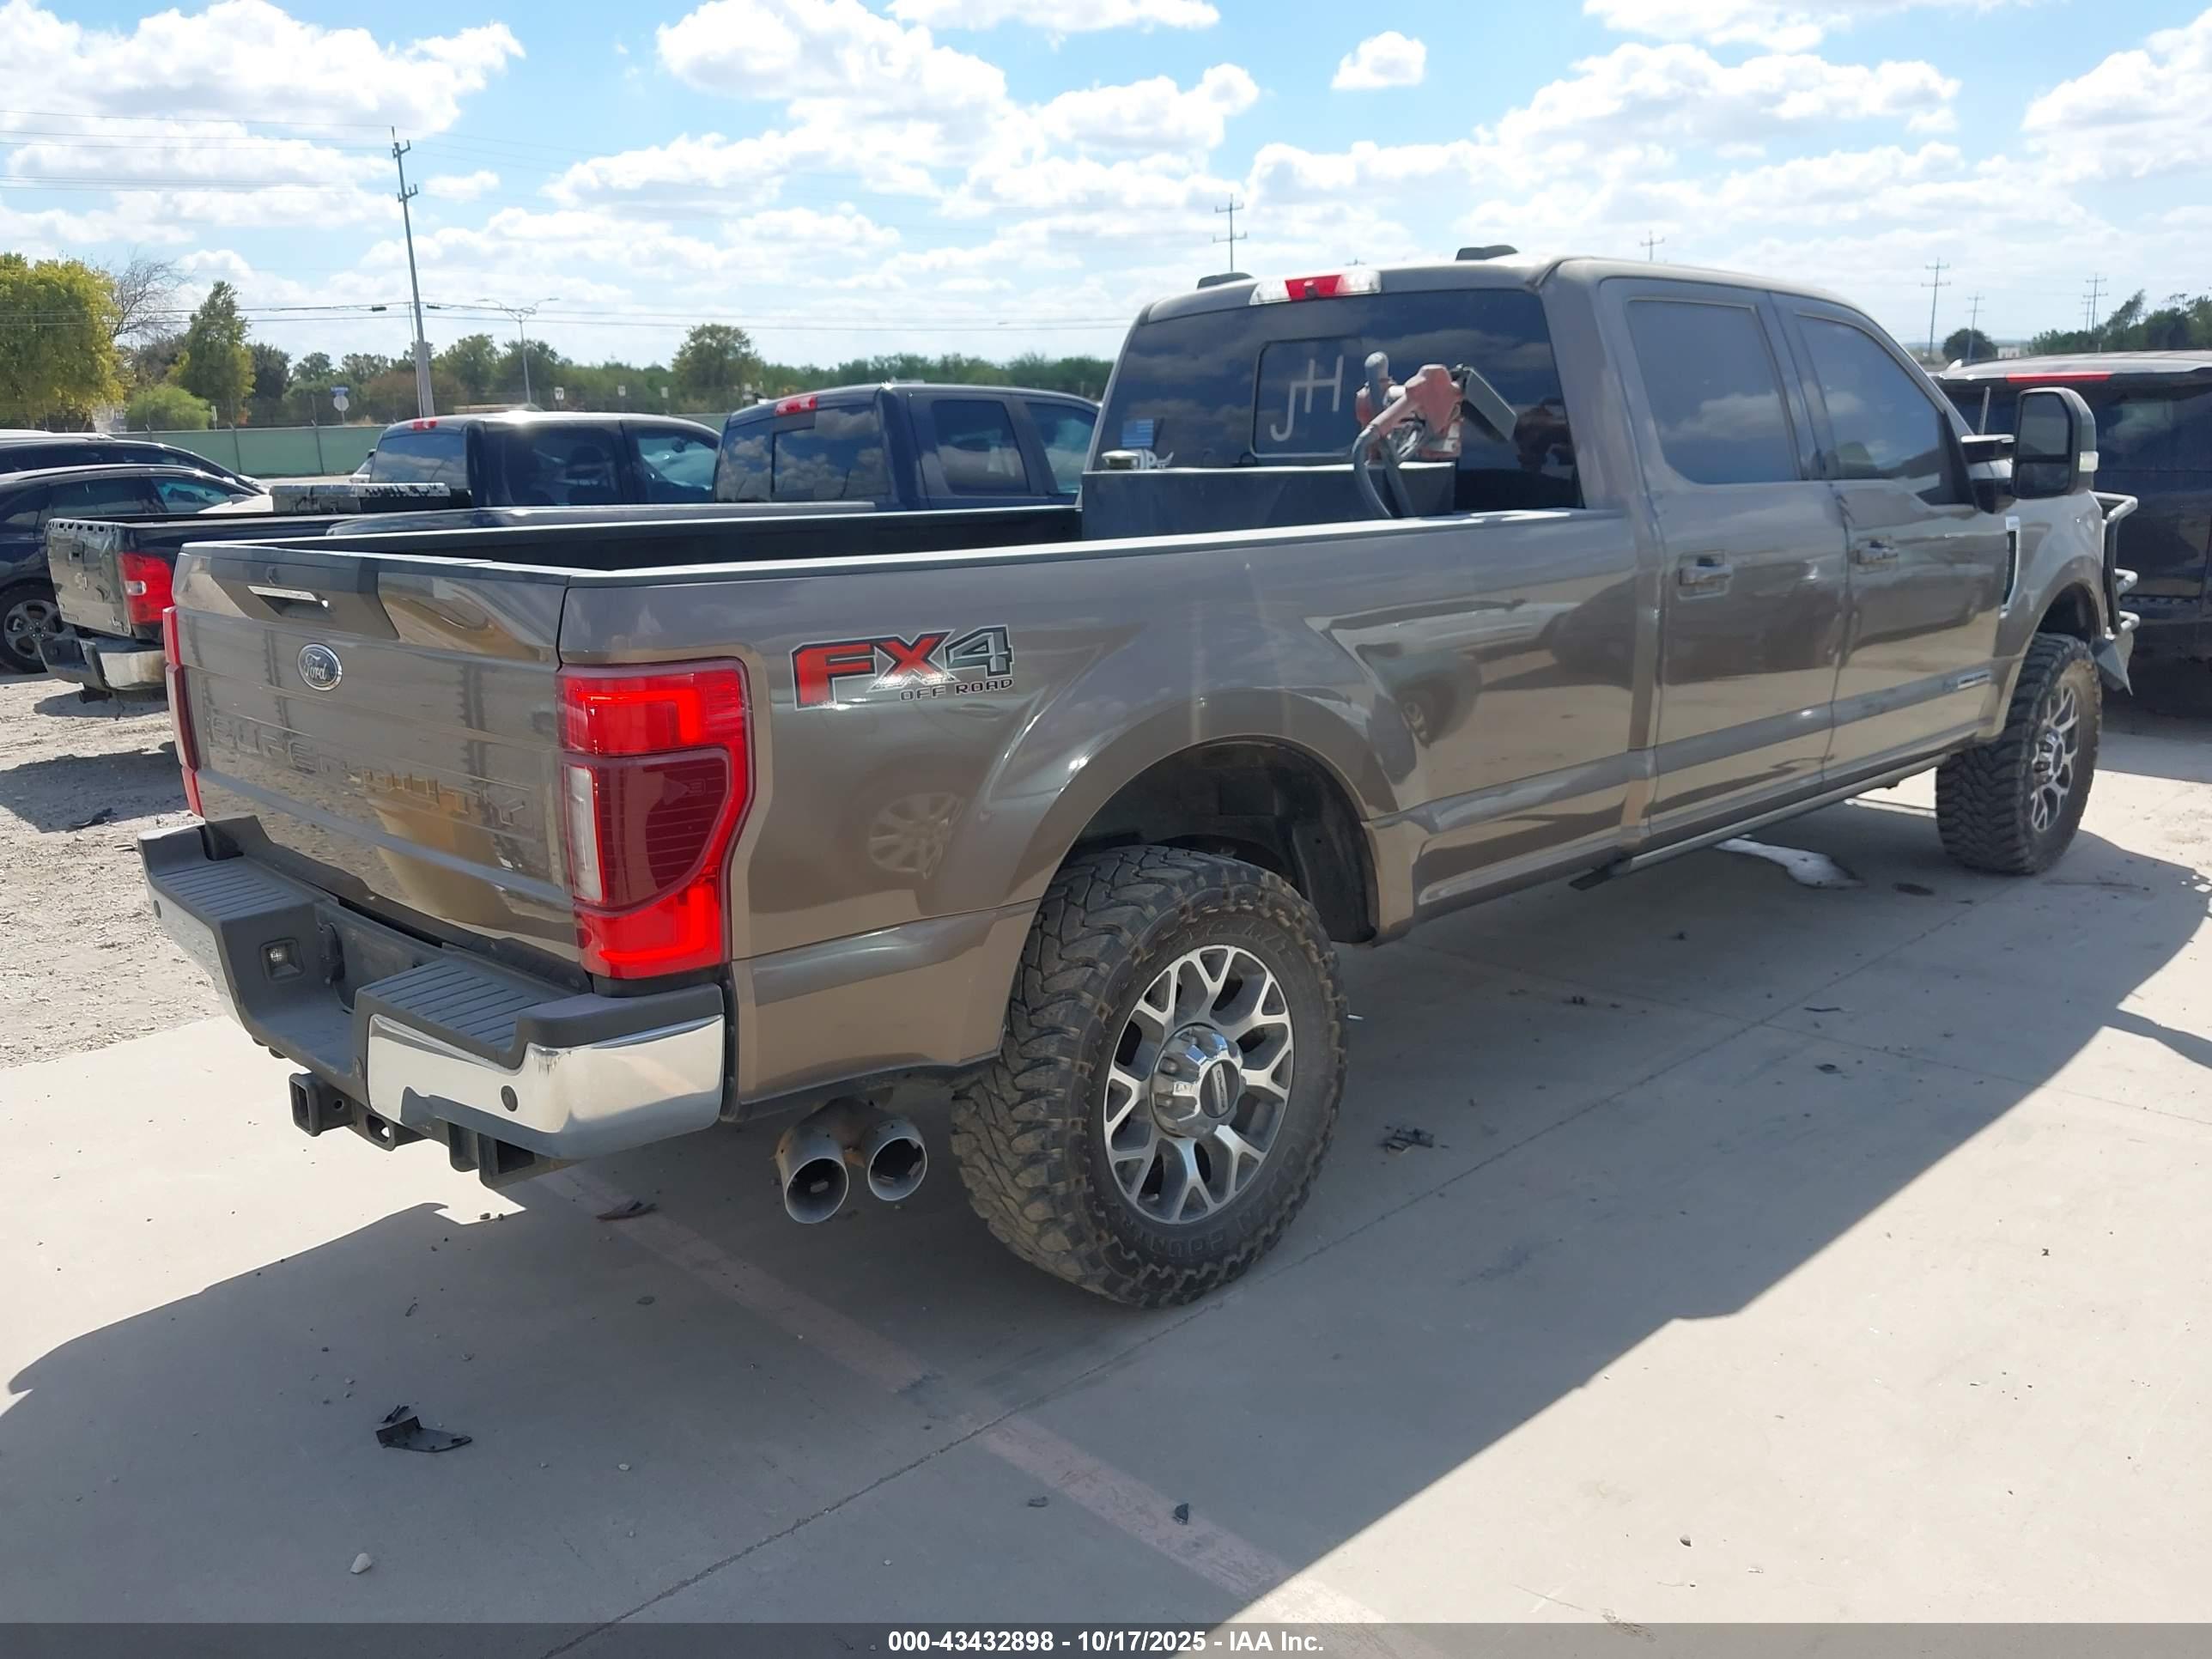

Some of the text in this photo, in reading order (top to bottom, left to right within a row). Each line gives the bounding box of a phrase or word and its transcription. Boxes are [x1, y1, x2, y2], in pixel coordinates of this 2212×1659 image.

[303, 653, 328, 681] Ford
[790, 624, 1015, 712] FX4
[899, 678, 1014, 702] OFF ROAD
